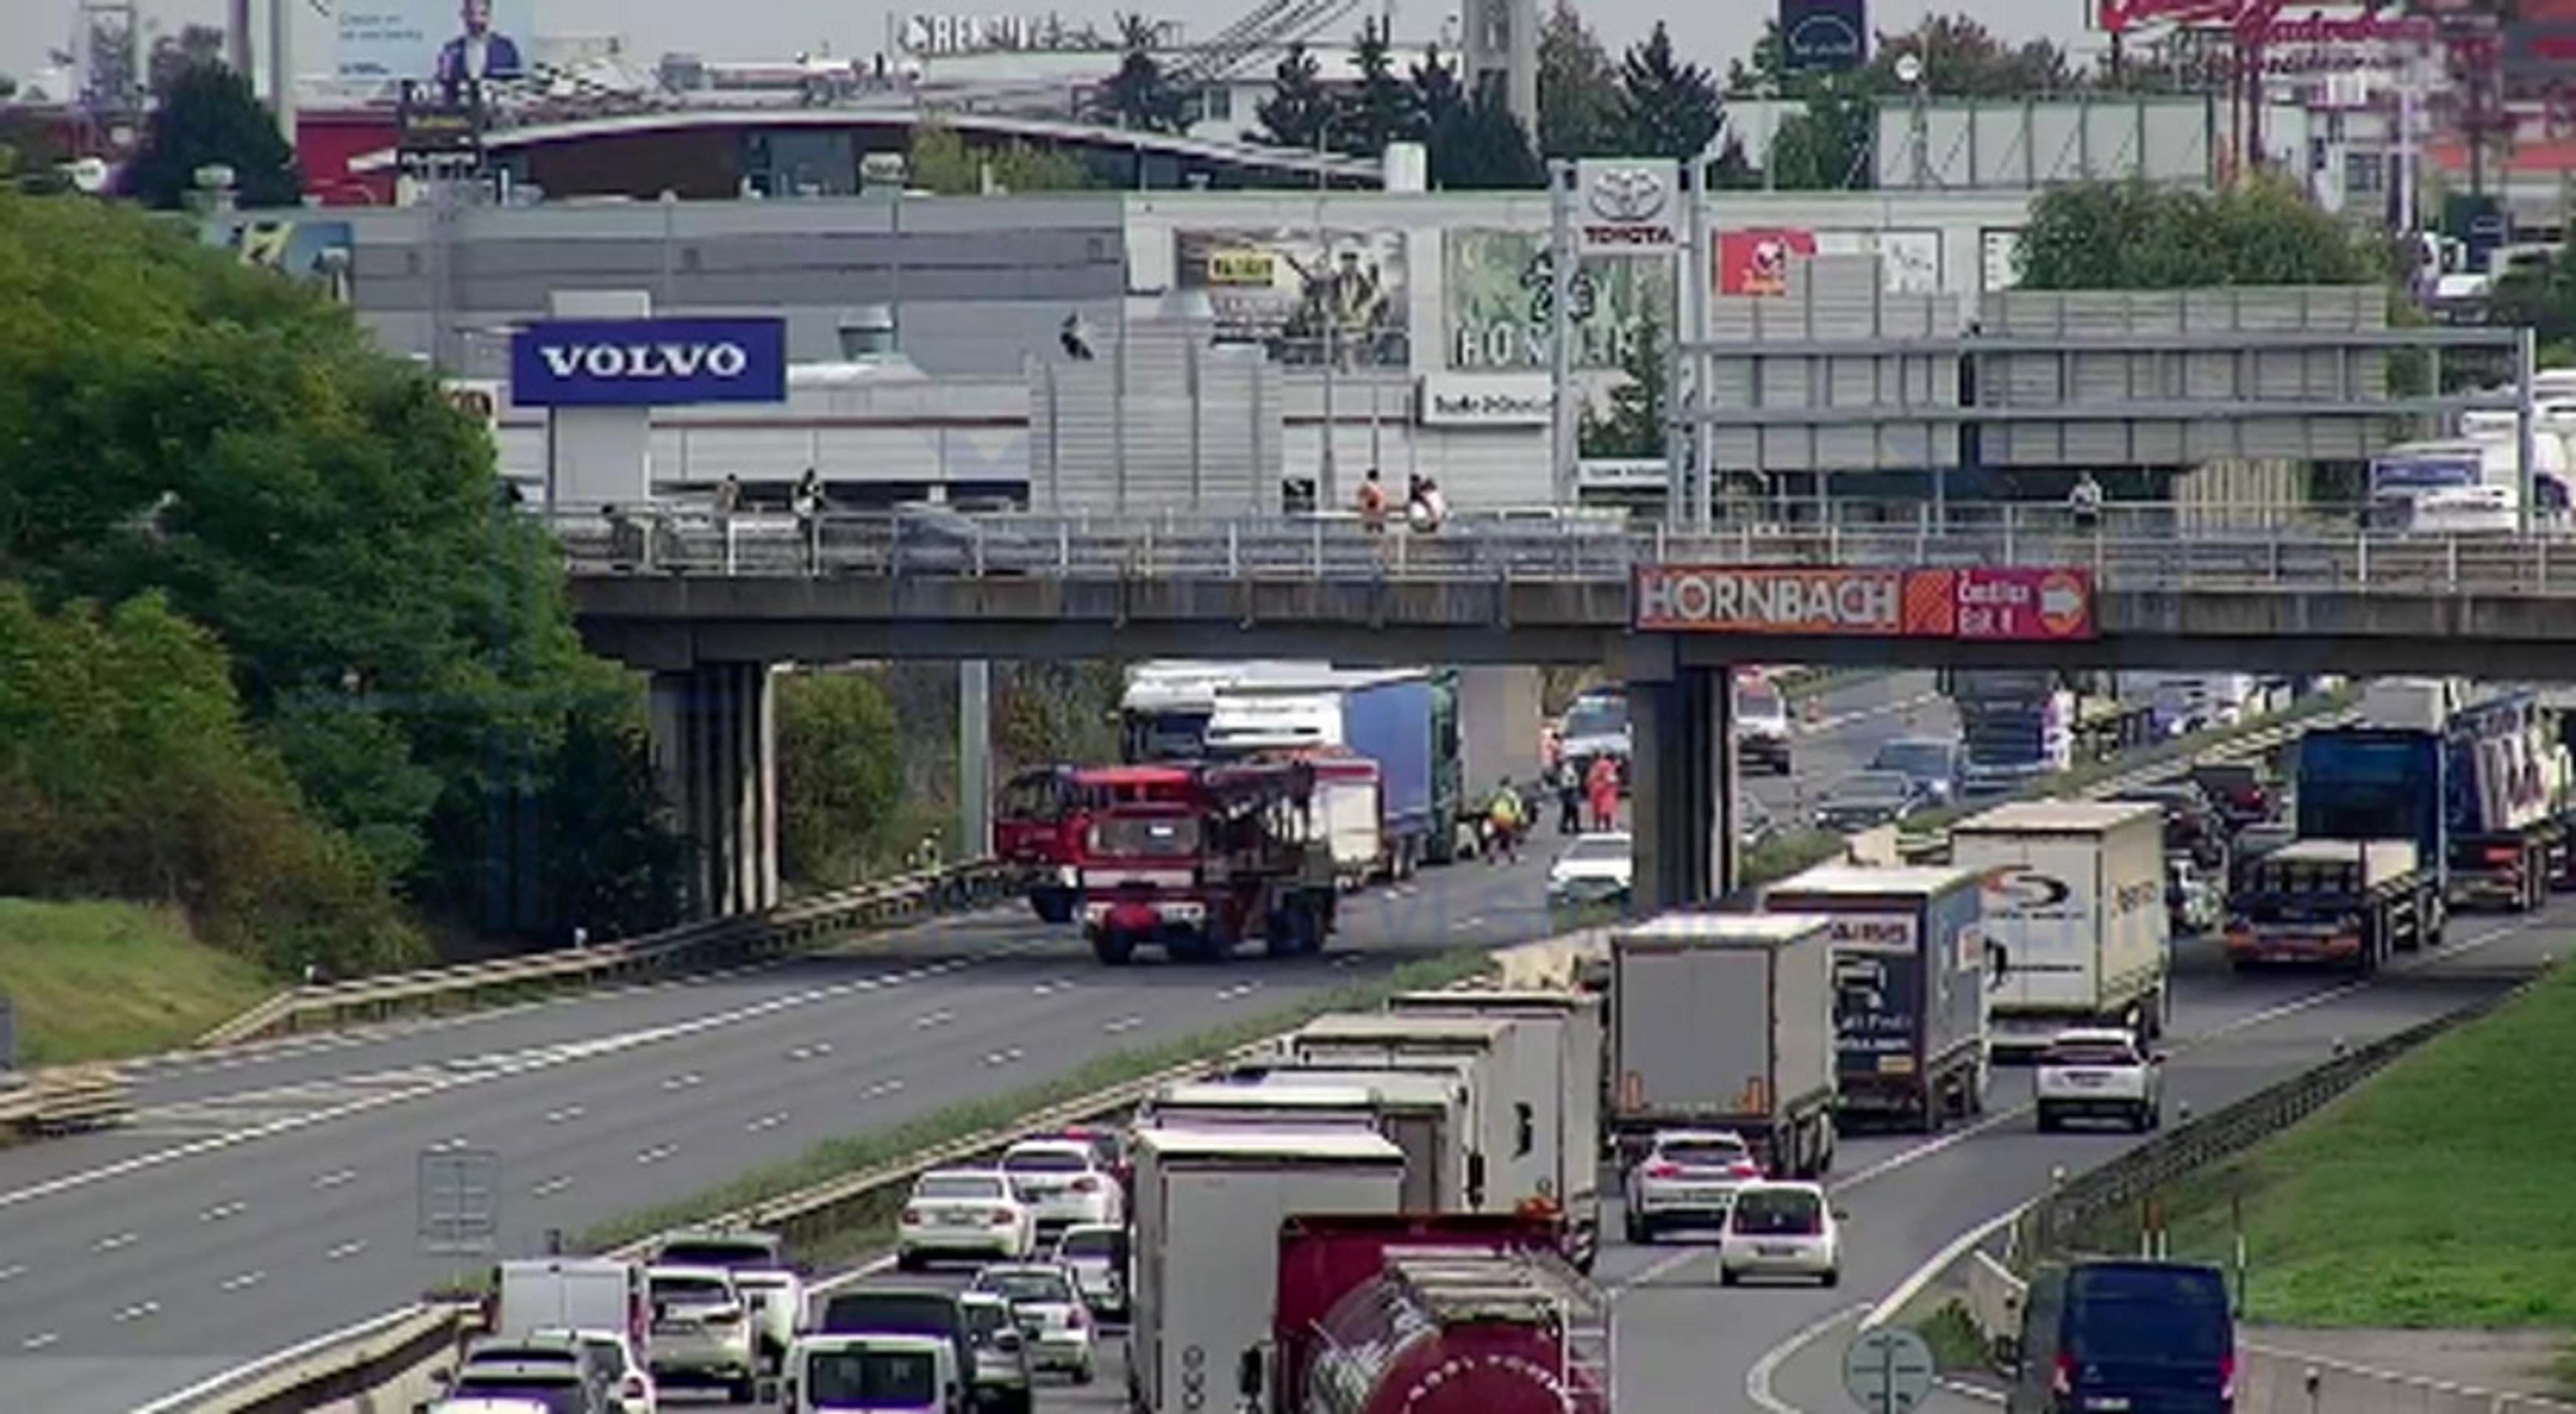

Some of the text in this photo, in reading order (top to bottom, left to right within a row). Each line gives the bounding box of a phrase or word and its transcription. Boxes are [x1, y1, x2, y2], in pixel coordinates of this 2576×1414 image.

[1583, 226, 1676, 245] TOYOTA
[540, 342, 747, 377] VOLVO
[1639, 573, 1898, 623] HORNBACH
